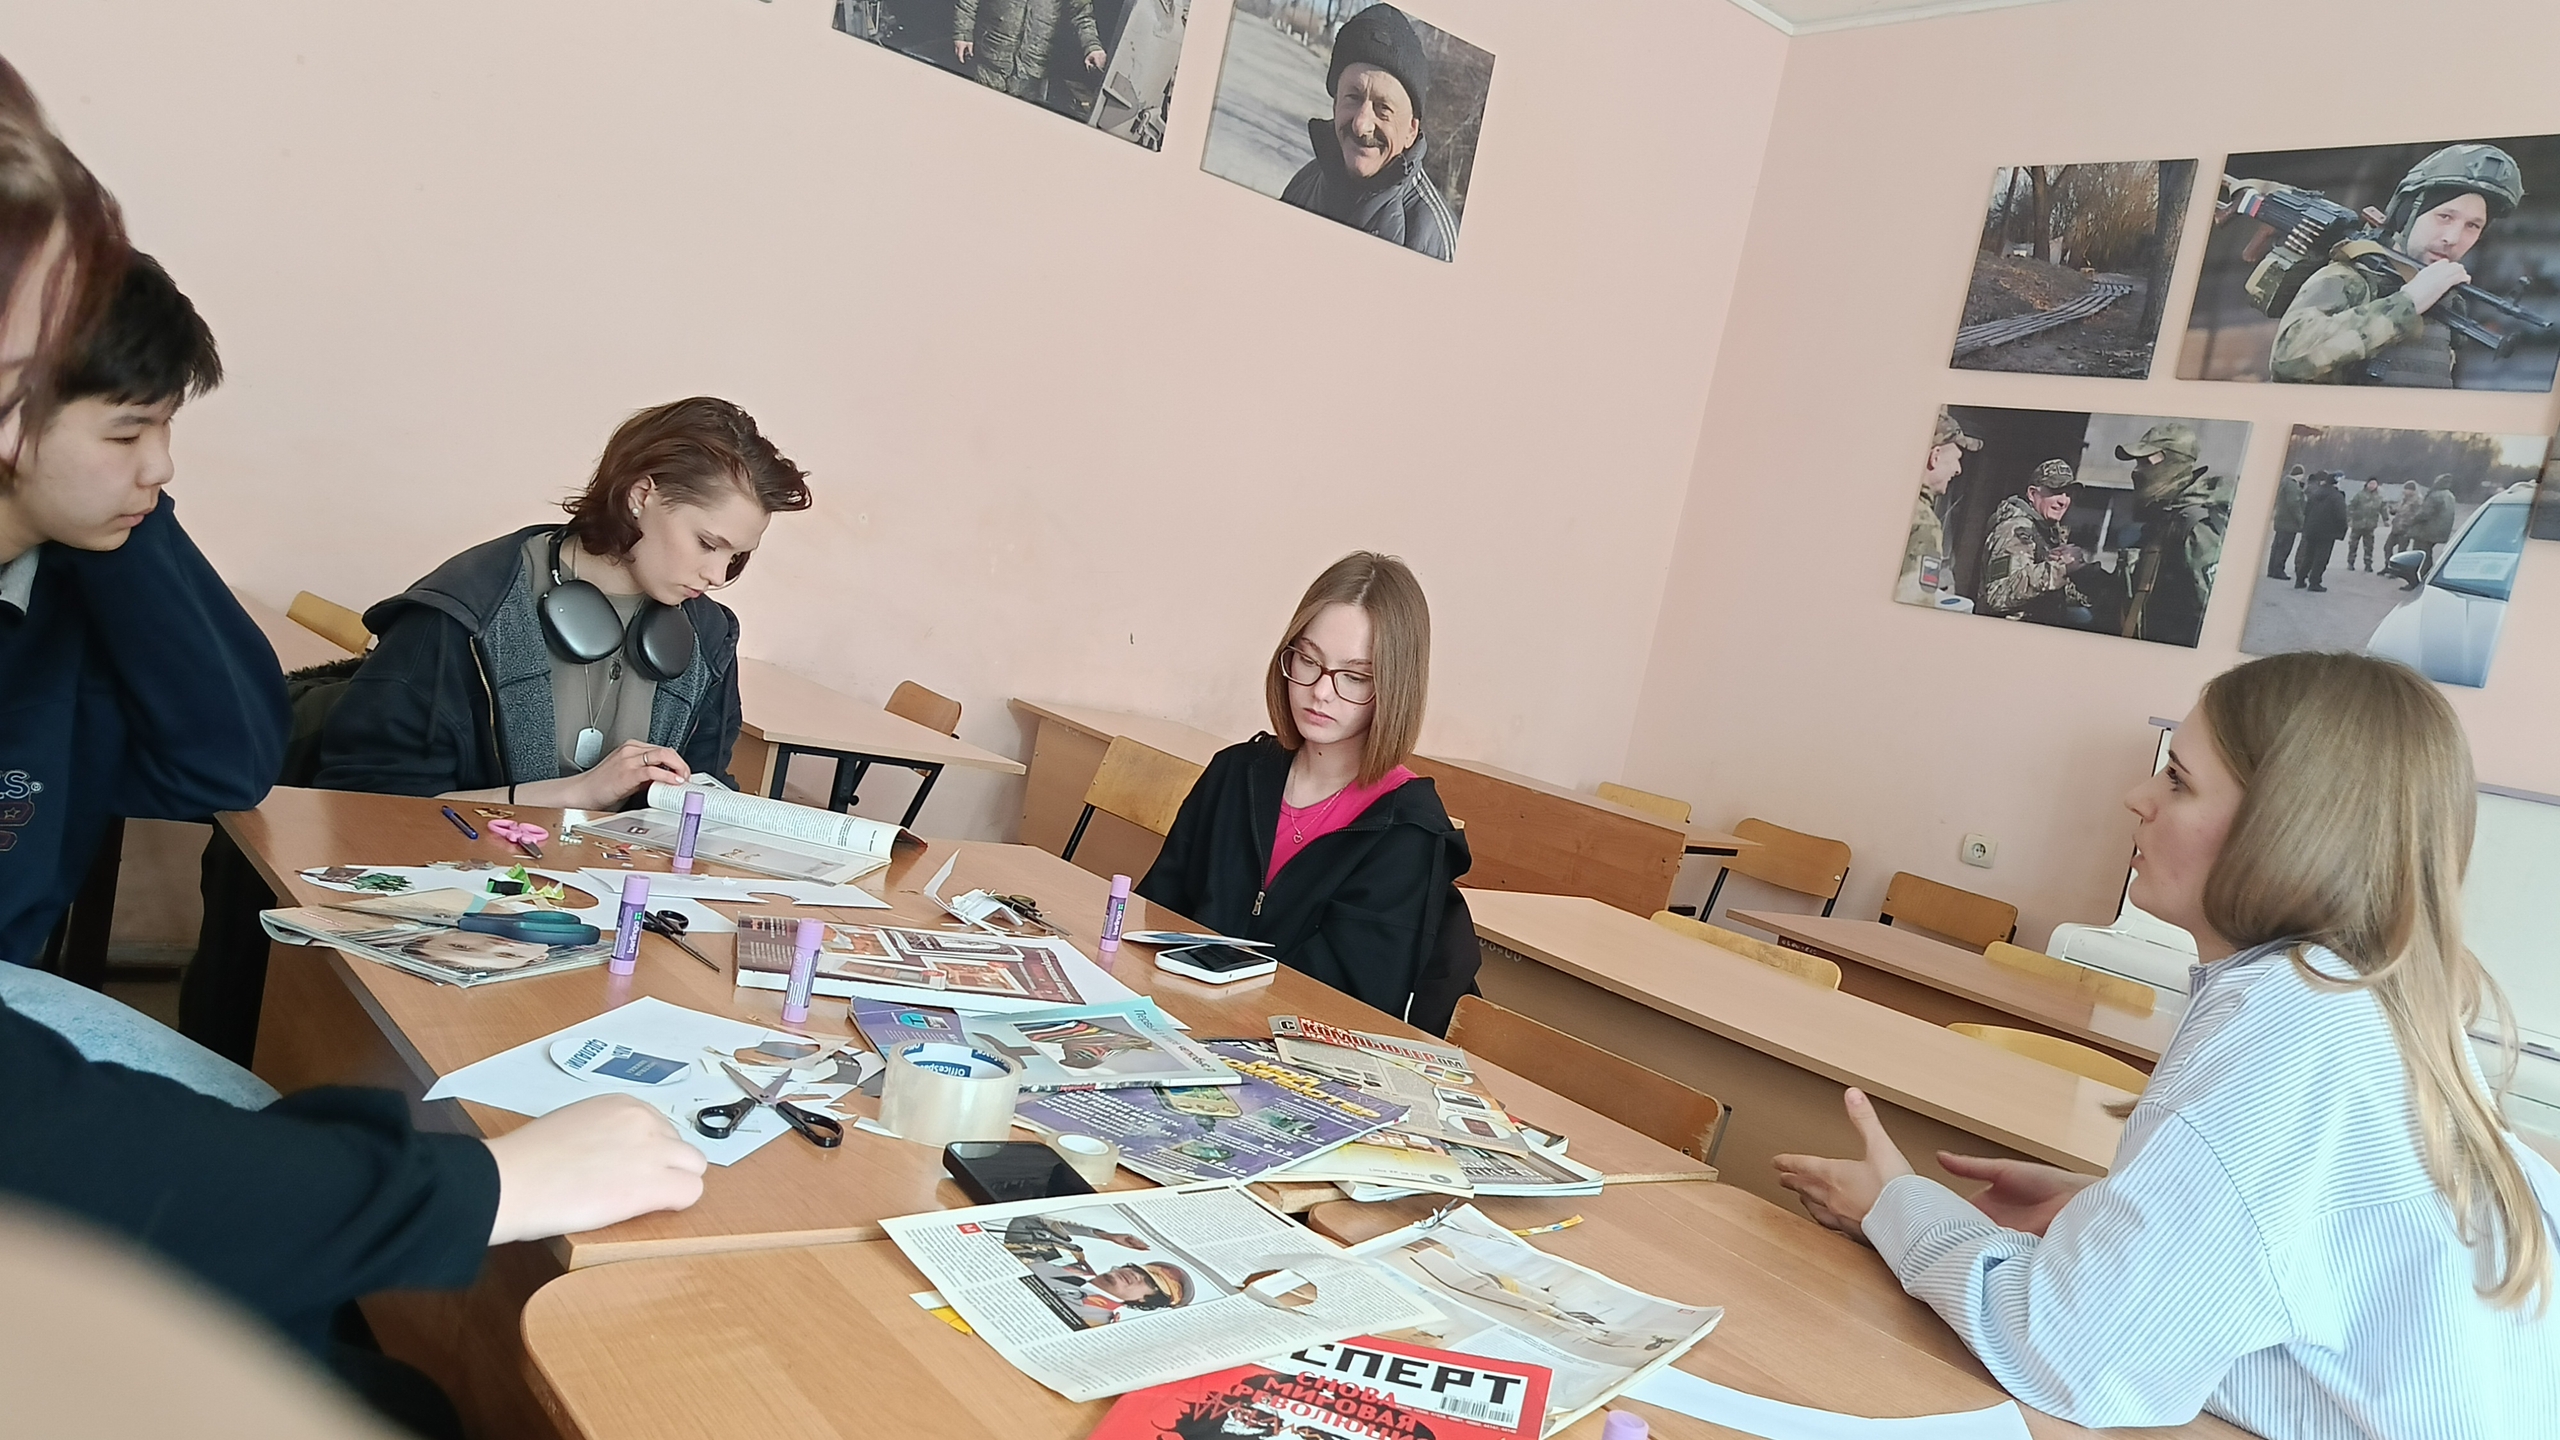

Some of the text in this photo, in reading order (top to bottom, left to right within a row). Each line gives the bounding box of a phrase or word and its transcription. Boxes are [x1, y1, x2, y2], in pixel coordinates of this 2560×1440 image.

[626, 920, 641, 954] berlingo
[919, 1063, 966, 1077] OfficeSpa
[1250, 1059, 1321, 1089] МОЙ
[1264, 1376, 1417, 1432] МИРОВАЯ
[1296, 1371, 1397, 1408] СНОВА
[1229, 1384, 1434, 1440] РЕВОЛЮЦИ
